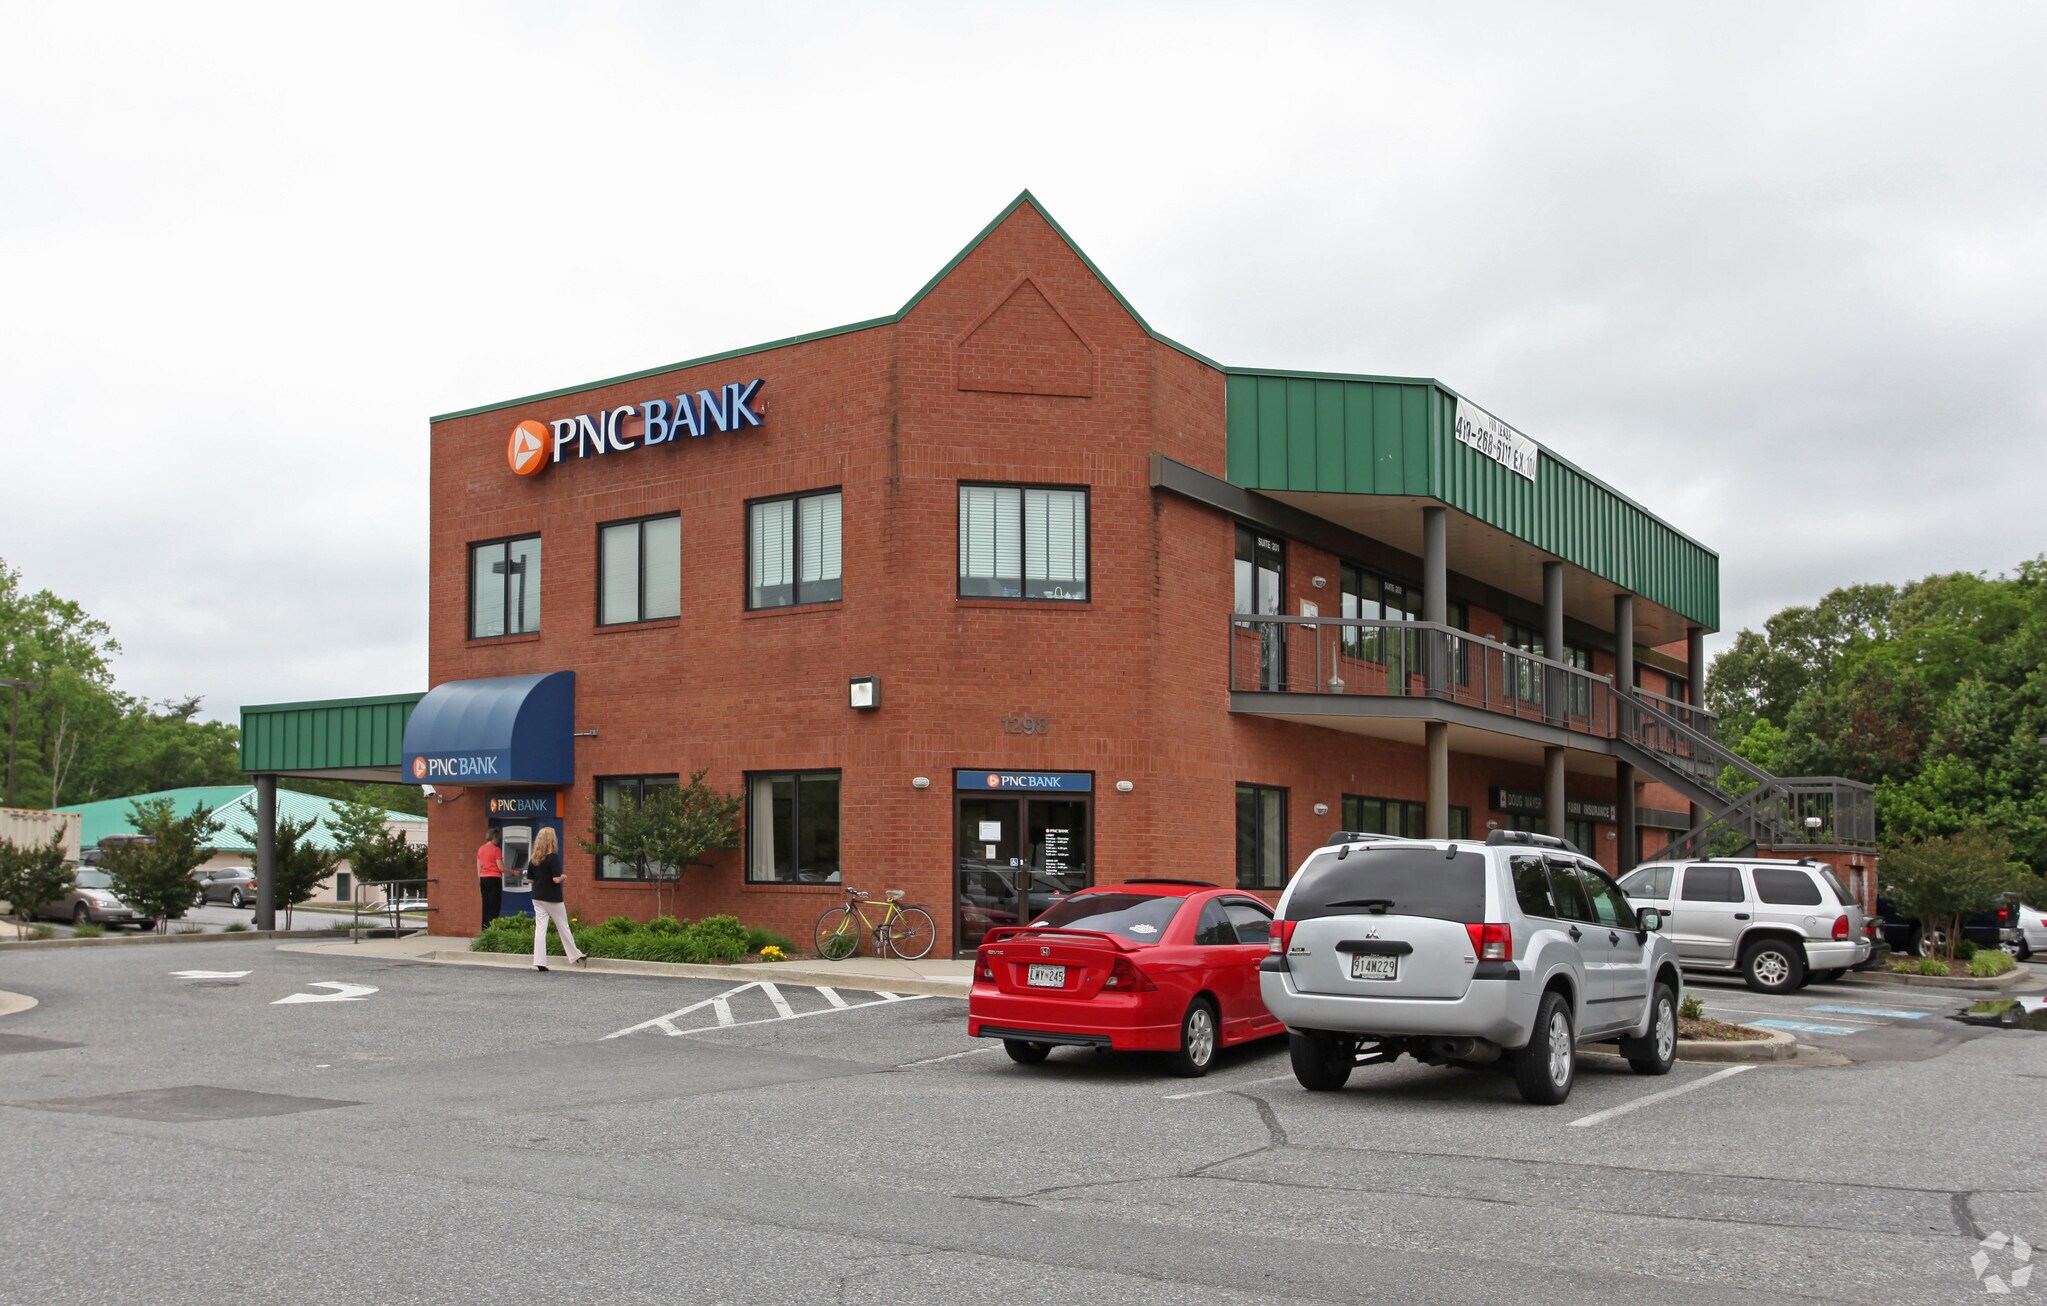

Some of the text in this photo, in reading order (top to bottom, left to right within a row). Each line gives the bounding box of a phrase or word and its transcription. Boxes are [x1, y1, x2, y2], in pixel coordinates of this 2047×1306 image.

[550, 379, 766, 463] PNC BANK
[1497, 424, 1512, 442] LEASE
[1258, 537, 1271, 550] SUITE
[1001, 716, 1049, 735] 1298
[428, 756, 498, 776] PNC BANK
[1001, 775, 1062, 788] PNC BANK
[497, 799, 548, 811] PNC BANK
[1508, 794, 1523, 807] DOUG
[1567, 801, 1581, 814] FARM
[1583, 804, 1610, 818] INSURANCE
[1049, 970, 1064, 982] 245
